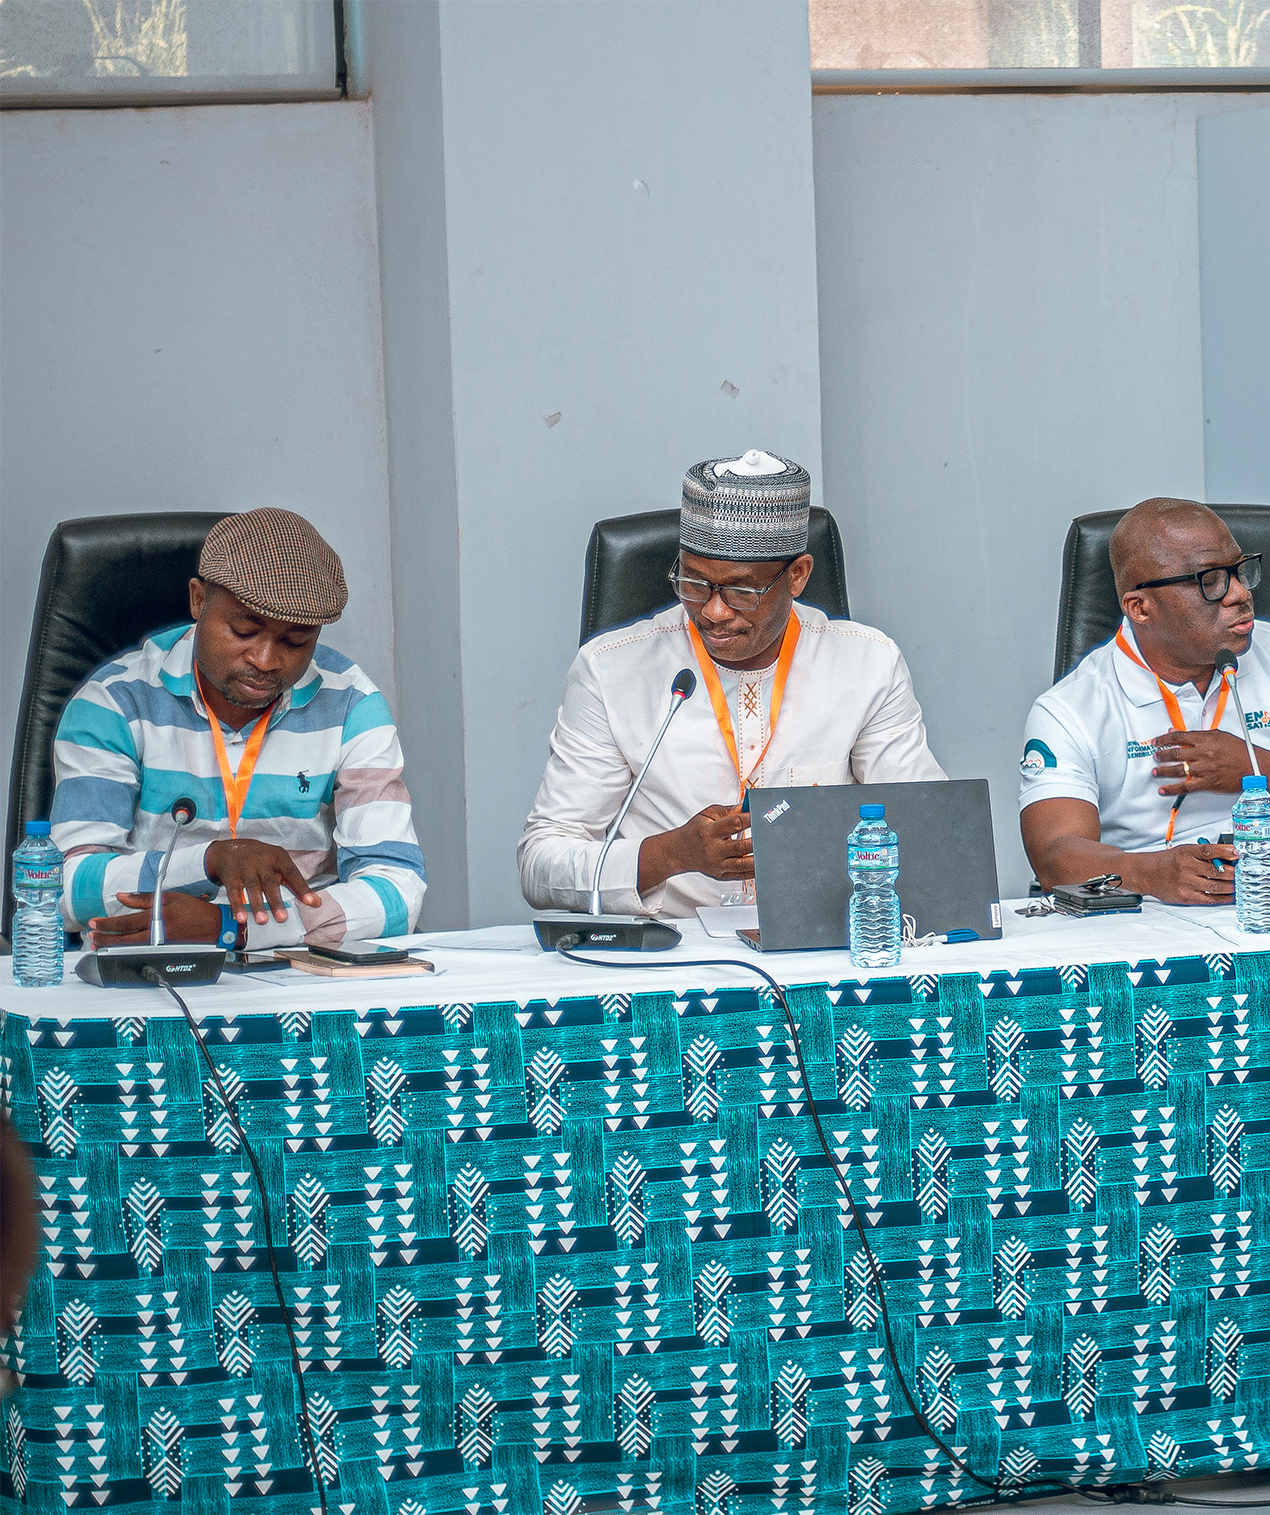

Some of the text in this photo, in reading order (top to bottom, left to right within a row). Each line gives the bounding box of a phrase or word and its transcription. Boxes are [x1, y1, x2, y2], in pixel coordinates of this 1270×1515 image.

[763, 800, 790, 824] ThinkPad
[856, 850, 880, 861] Voltic
[26, 869, 52, 879] Voltic
